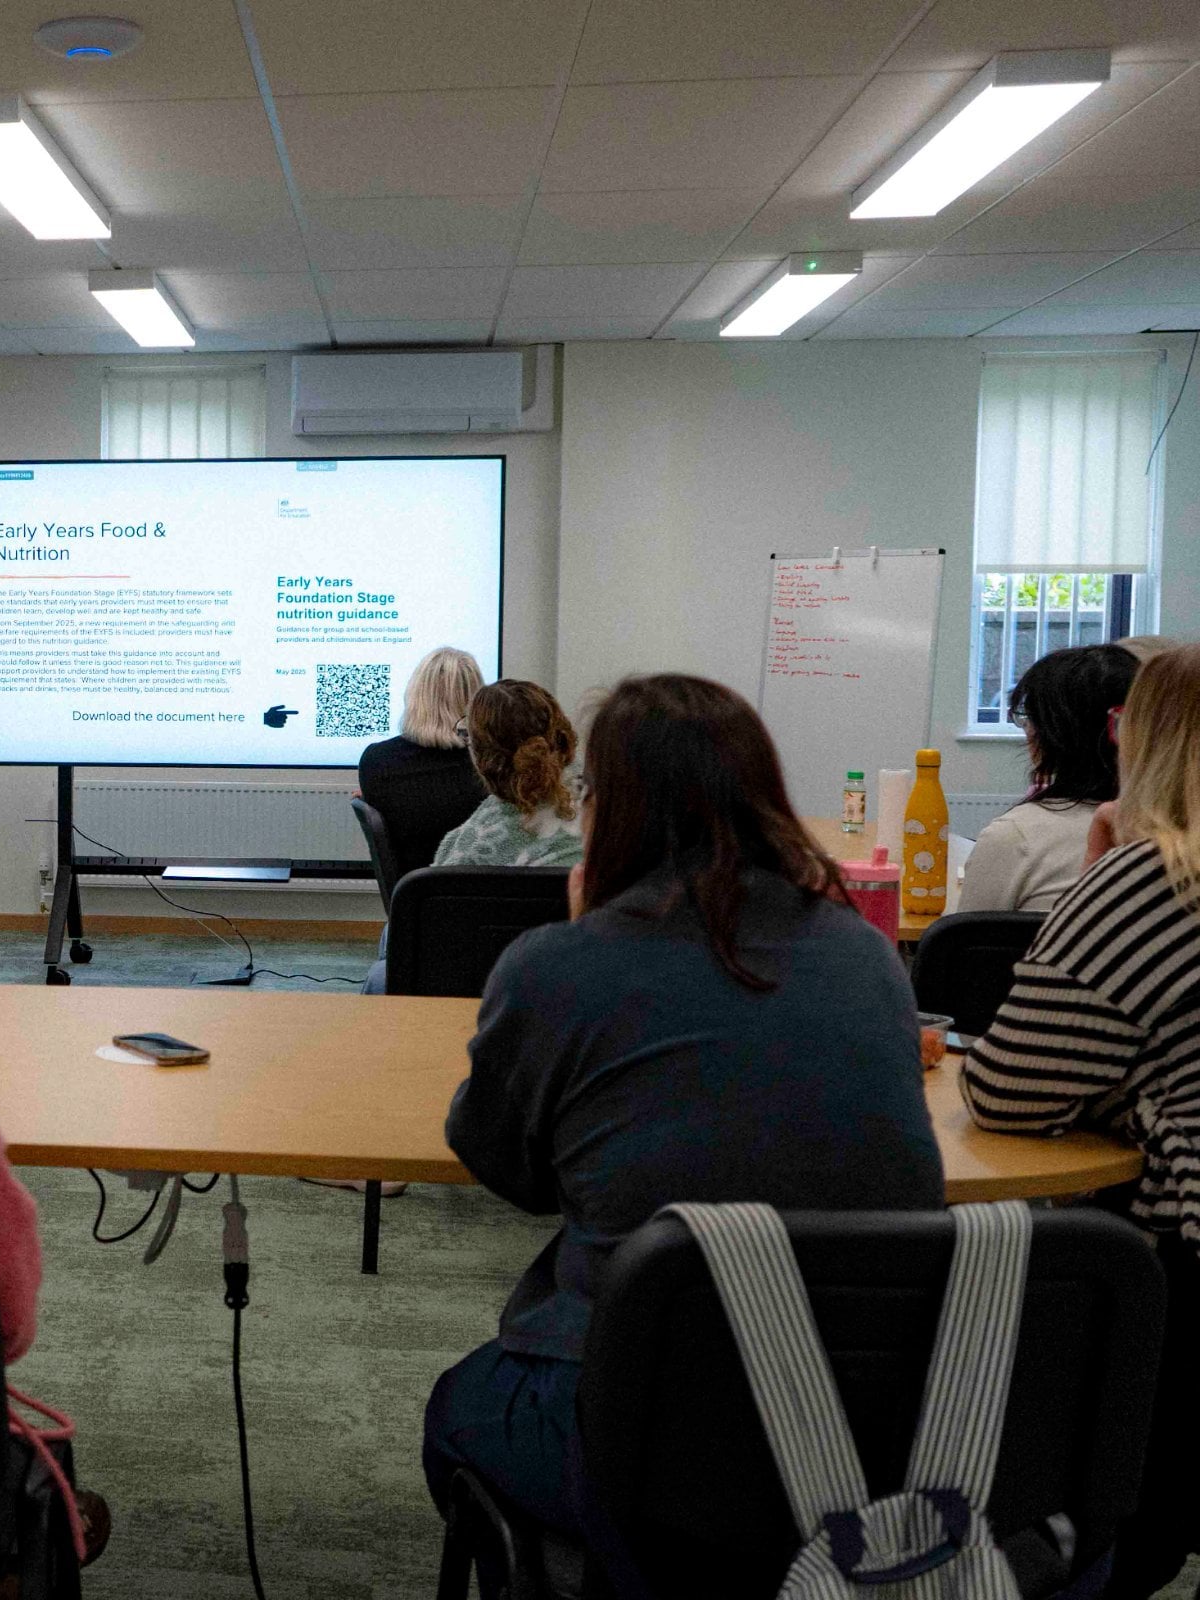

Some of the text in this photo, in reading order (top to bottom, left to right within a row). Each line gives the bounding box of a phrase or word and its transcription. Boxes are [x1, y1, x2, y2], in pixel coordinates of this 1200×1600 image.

[43, 523, 95, 538] Years
[101, 522, 147, 538] Food
[154, 522, 166, 538] &
[277, 576, 353, 590] Early Years
[9, 589, 27, 598] Early
[29, 589, 49, 597] Years
[51, 589, 92, 597] Foundation
[94, 589, 115, 598] Stage
[117, 589, 141, 598] (EYFS)
[142, 589, 174, 598] statutory
[176, 589, 215, 597] framework
[217, 589, 232, 597] sets
[59, 599, 77, 607] early
[100, 599, 135, 607] providers
[277, 592, 395, 605] Foundation Stage
[277, 608, 399, 621] nutrition guidance
[13, 620, 53, 628] September
[103, 620, 146, 628] requirement
[171, 620, 219, 628] safeguarding
[382, 636, 412, 644] England
[36, 649, 69, 658] providers
[124, 649, 156, 658] guidance
[103, 659, 122, 667] good
[193, 659, 227, 667] guidance
[22, 668, 56, 676] providers
[137, 668, 176, 676] implement
[191, 668, 220, 676] existing
[152, 677, 185, 685] provided
[72, 711, 245, 722] Download the document here
